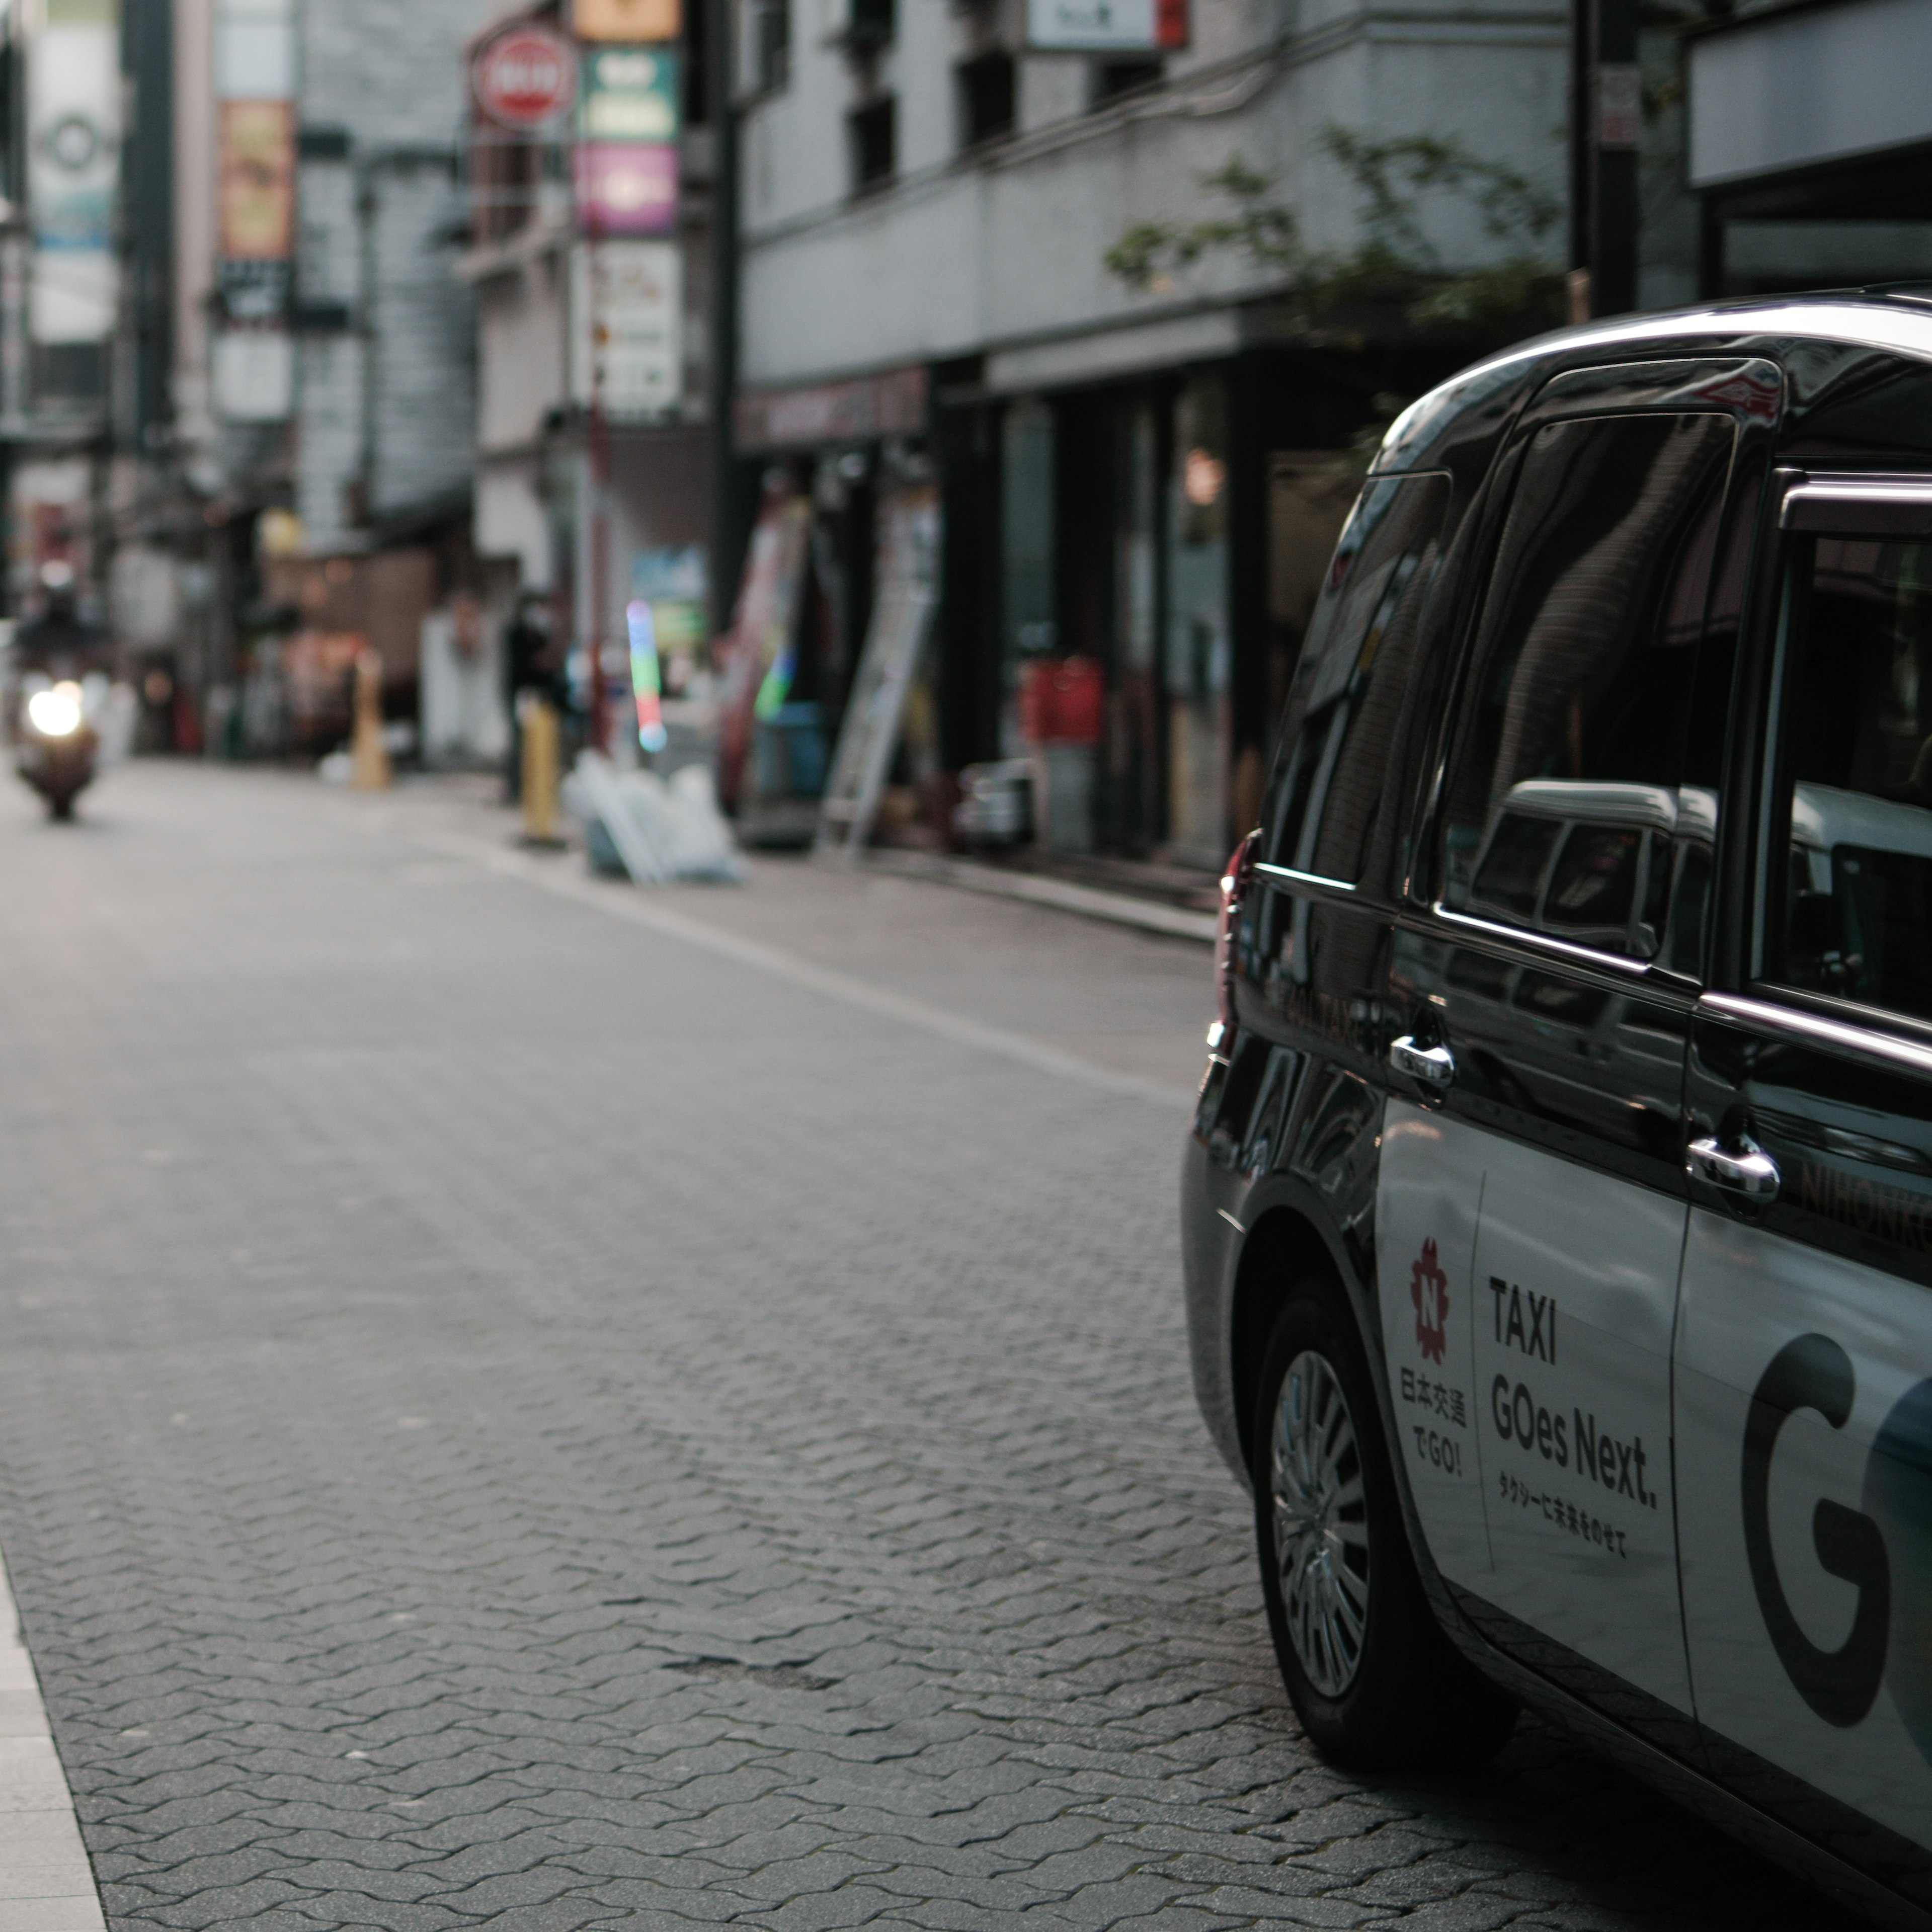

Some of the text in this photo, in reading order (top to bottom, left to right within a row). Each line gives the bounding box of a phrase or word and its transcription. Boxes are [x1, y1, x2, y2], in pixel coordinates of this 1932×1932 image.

[1489, 1275, 1556, 1366] TAXI
[1401, 1366, 1467, 1428] 日本交通
[1491, 1373, 1658, 1510] GOes Next.
[1500, 1470, 1627, 1559] タクシーに未来をのせて
